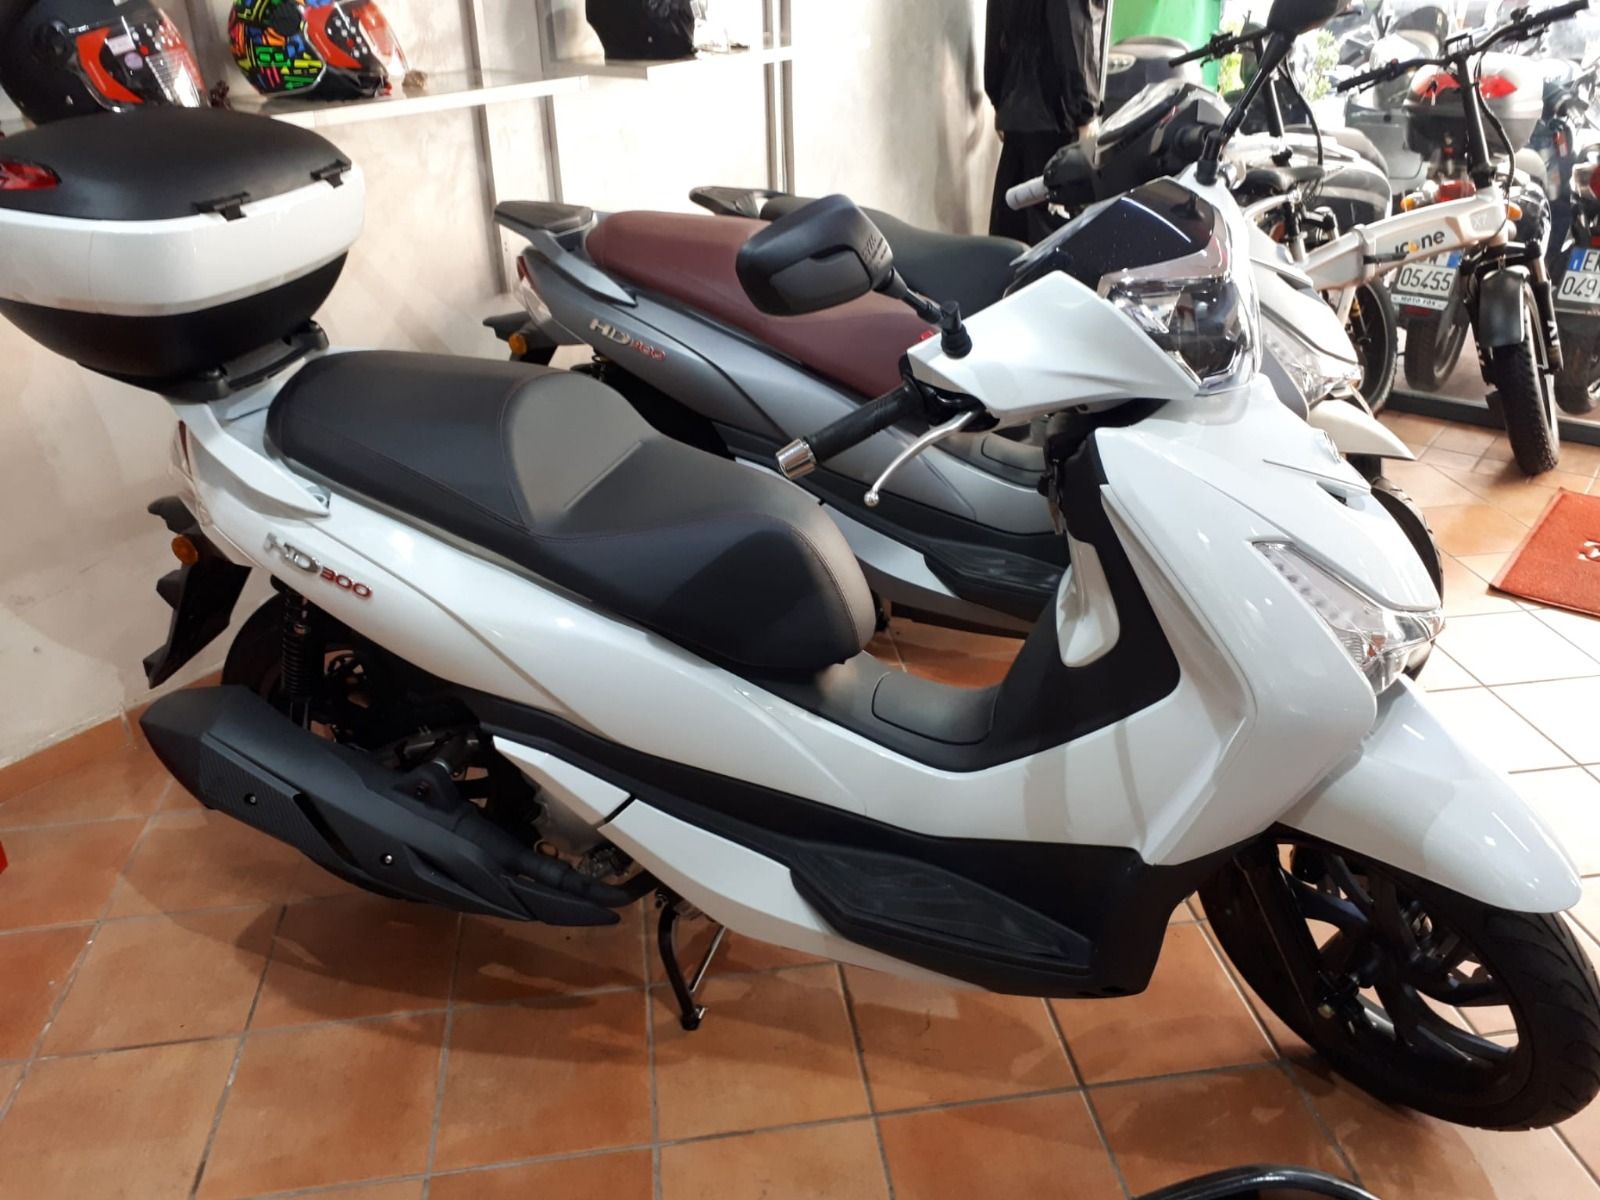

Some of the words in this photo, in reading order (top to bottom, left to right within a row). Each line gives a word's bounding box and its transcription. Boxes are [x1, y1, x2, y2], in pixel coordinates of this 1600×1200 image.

[1400, 267, 1453, 291] 05455
[1562, 276, 1600, 298] 049
[263, 532, 373, 598] HD300
